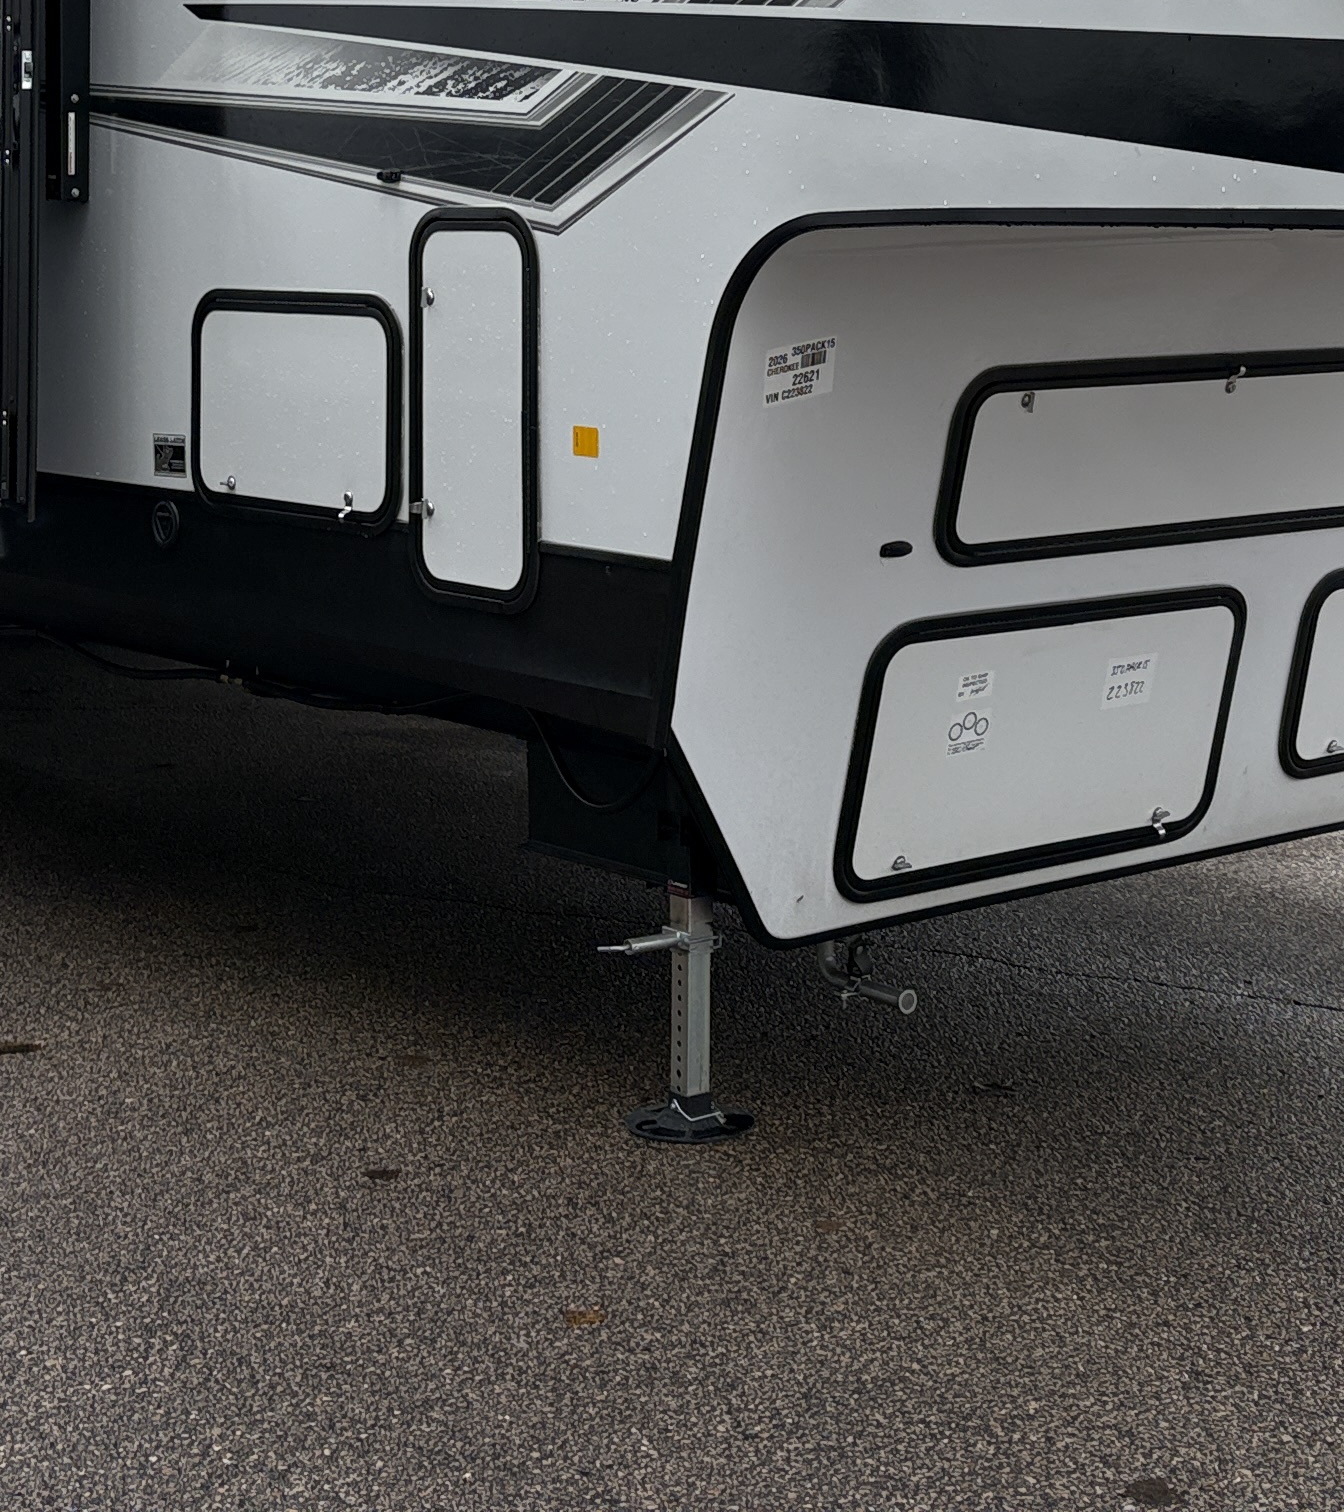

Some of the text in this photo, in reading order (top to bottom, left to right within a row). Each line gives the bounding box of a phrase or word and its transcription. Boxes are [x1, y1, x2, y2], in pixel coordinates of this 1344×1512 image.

[768, 338, 835, 368] 2026 350PACK15
[767, 362, 799, 377] CHEROKEE
[792, 368, 820, 386] 22621
[765, 391, 780, 405] VIN
